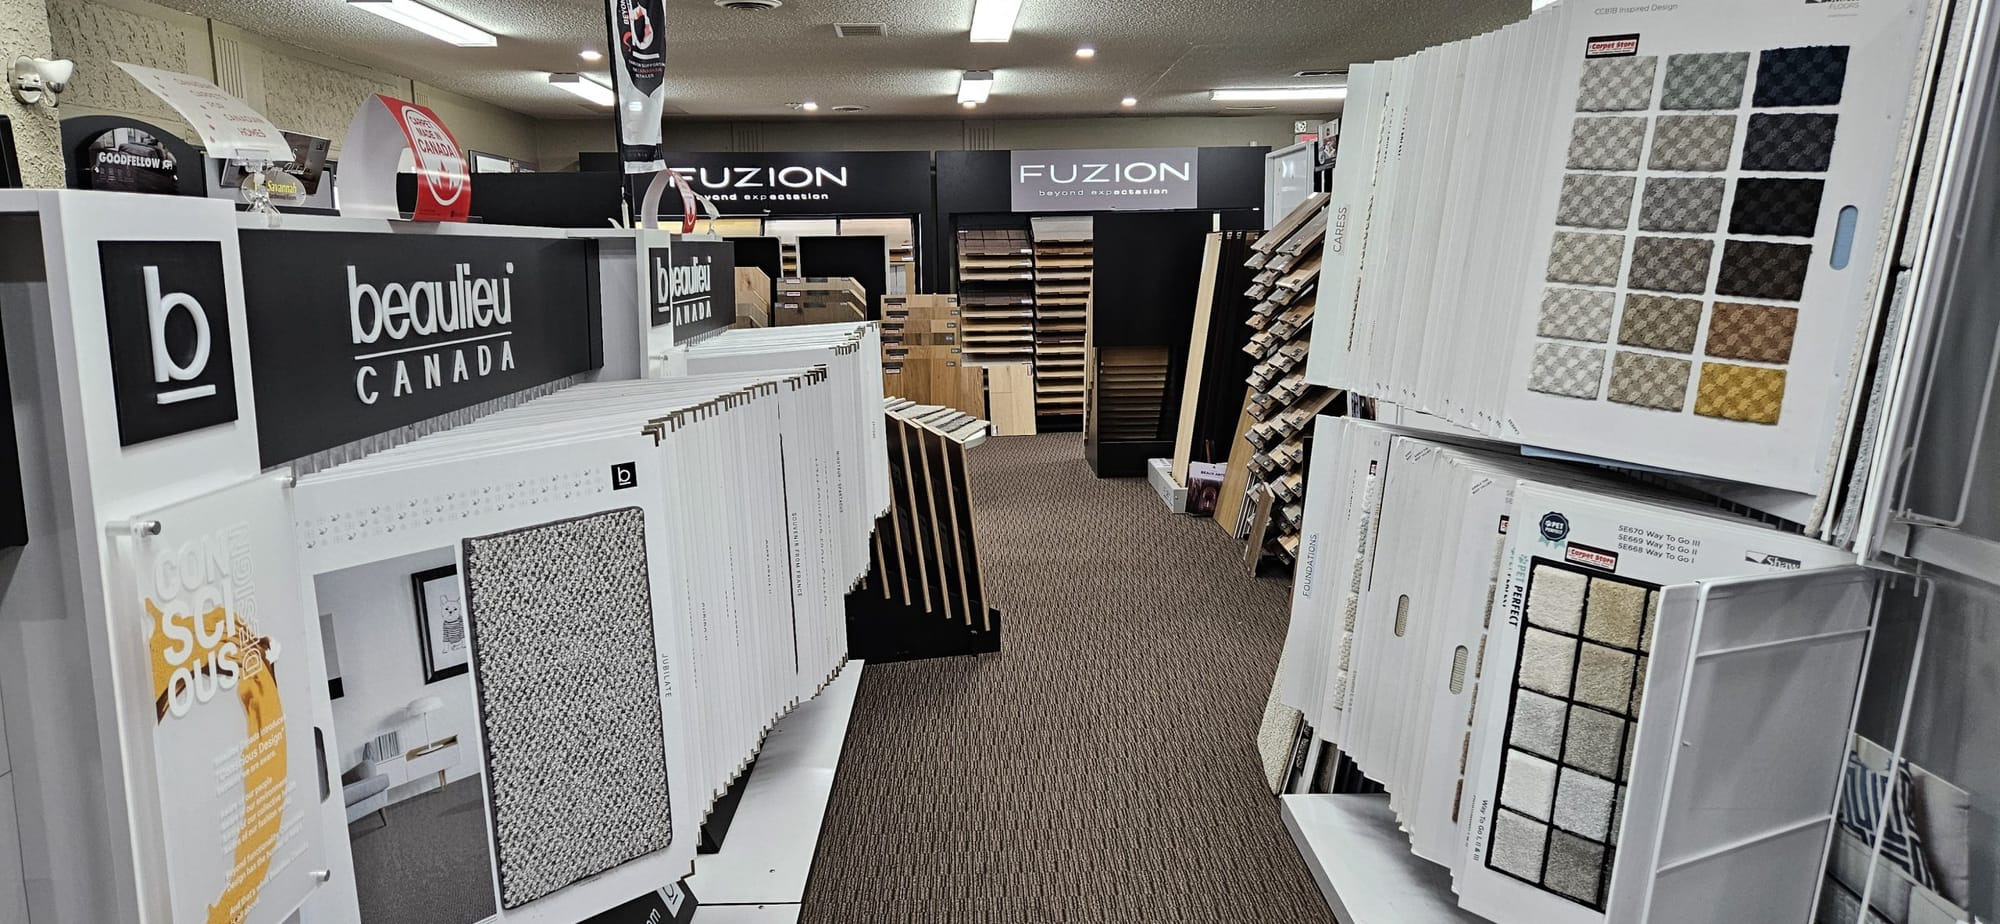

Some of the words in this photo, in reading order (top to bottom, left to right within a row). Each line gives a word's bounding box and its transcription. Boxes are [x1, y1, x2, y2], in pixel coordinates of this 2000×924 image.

[1620, 4, 1649, 13] Inspired
[1651, 3, 1679, 12] Design
[1617, 41, 1635, 49] Store
[417, 138, 457, 158] CANADA
[99, 151, 161, 169] GOODFELLOW
[668, 166, 847, 188] FUZION
[1020, 162, 1190, 184] FUZION
[267, 181, 297, 194] Savannah
[744, 192, 829, 201] expectation
[1039, 189, 1084, 197] beyond
[1091, 188, 1169, 197] expectation
[1333, 207, 1347, 253] CARESS
[347, 262, 513, 344] beaulieu
[143, 265, 211, 383] b
[356, 340, 515, 405] CANADA
[791, 512, 799, 547] SOUVENIR
[1551, 521, 1564, 530] PET
[1646, 530, 1664, 540] Way
[1666, 534, 1676, 542] To
[1678, 537, 1690, 545] Go
[1646, 539, 1664, 549] Way
[1666, 543, 1675, 551] To
[1677, 546, 1690, 554] Go
[155, 527, 231, 601] CON
[1571, 549, 1594, 560] Carpet
[1595, 554, 1614, 564] Store
[1645, 548, 1663, 558] Way
[1666, 552, 1675, 560] To
[1677, 555, 1690, 563] Go
[1767, 556, 1801, 570] Shaw
[1302, 533, 1318, 598] FOUNDATIONS
[1515, 564, 1527, 583] PET
[228, 521, 263, 681] DESIGN
[1508, 585, 1524, 628] PERFECT
[162, 577, 236, 666] SCI
[168, 641, 240, 718] OUS
[661, 653, 672, 698] JUBILATE
[255, 776, 273, 796] people
[1480, 799, 1489, 815] Way
[1480, 816, 1486, 824] To
[1477, 825, 1485, 835] Go
